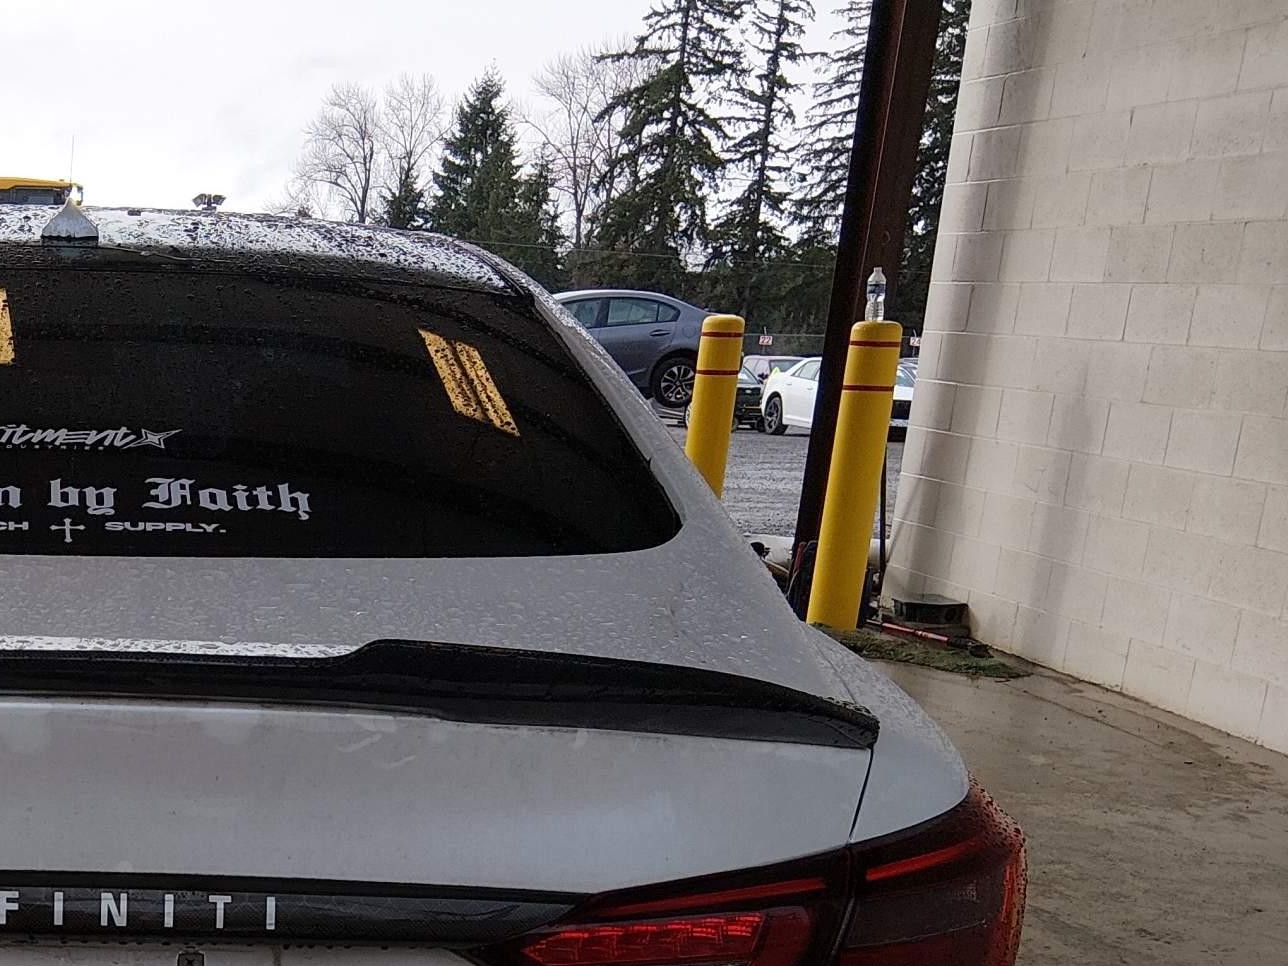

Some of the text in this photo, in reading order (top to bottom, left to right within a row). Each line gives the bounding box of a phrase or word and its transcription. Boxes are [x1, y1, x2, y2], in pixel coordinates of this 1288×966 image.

[47, 478, 118, 516] by
[142, 477, 312, 521] Faith
[104, 521, 227, 534] SUPPLY.
